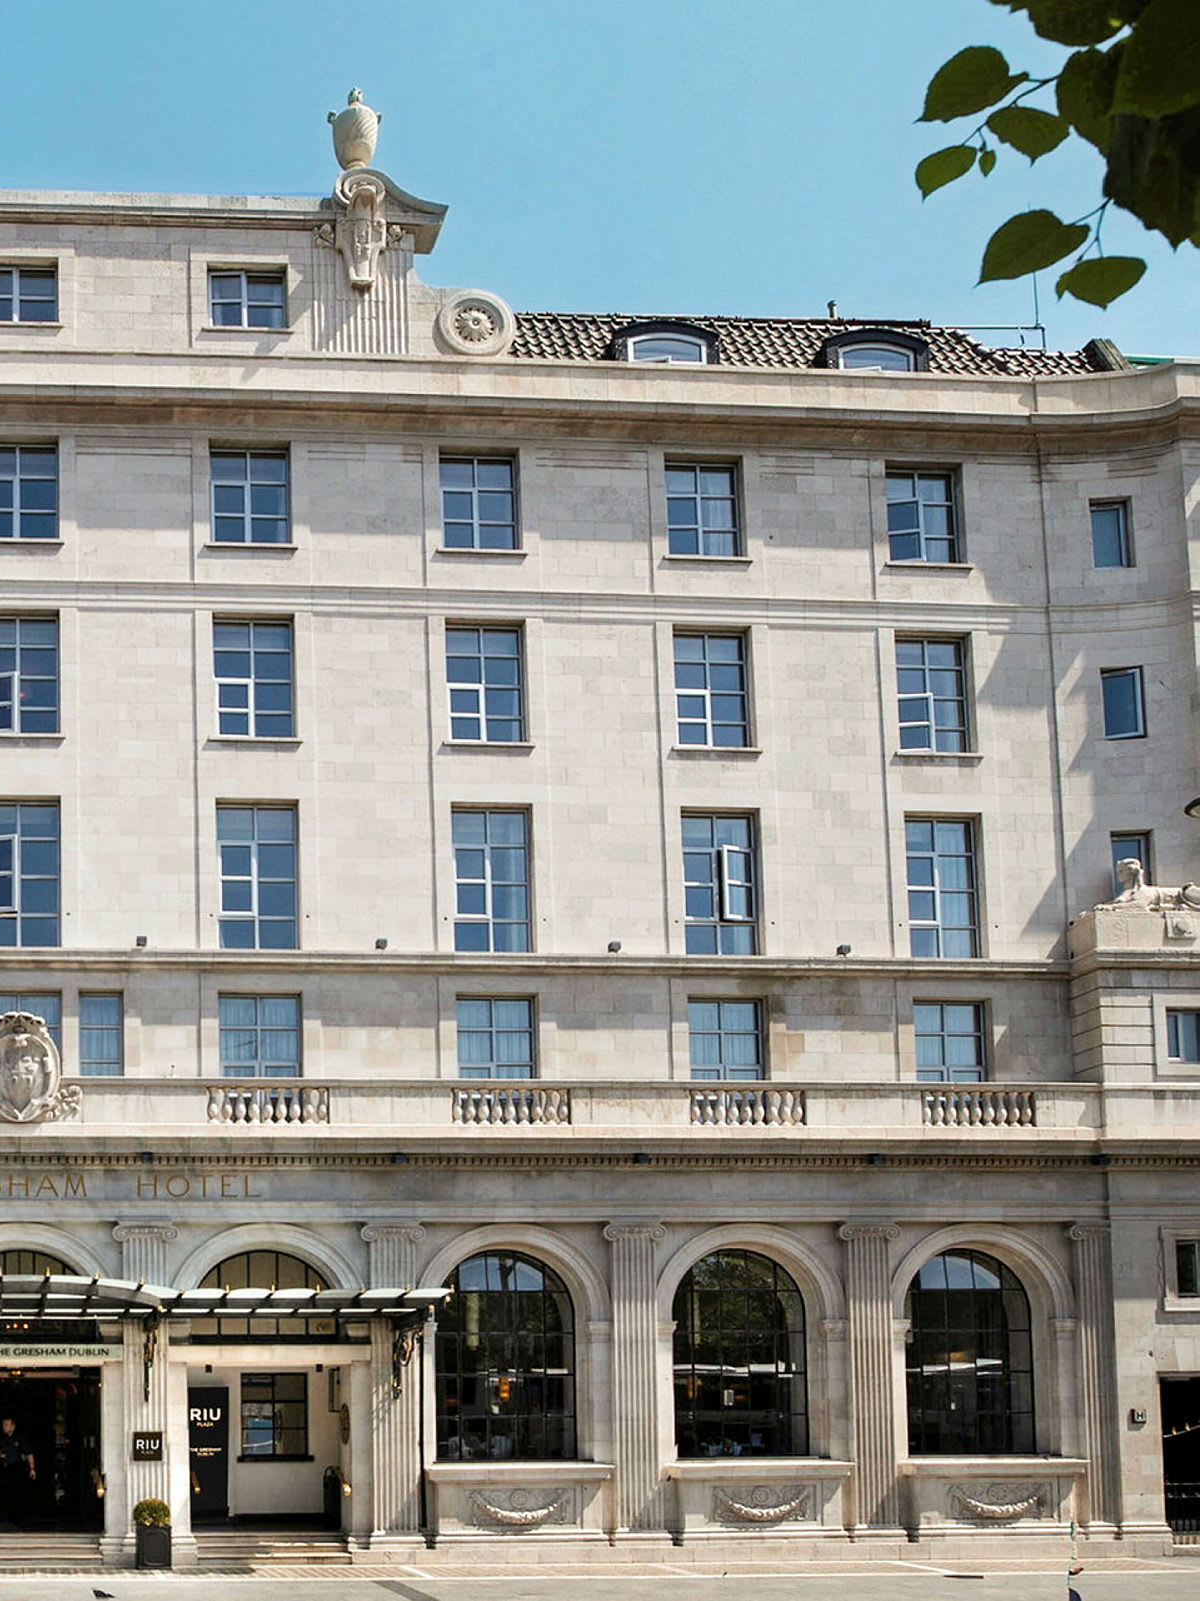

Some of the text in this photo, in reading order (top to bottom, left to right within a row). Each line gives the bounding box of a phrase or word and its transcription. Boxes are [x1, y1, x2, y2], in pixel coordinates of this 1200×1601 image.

[136, 1173, 263, 1198] HOTEL
[13, 1347, 66, 1356] GRESHAM
[69, 1347, 109, 1356] DUBLIN
[190, 1408, 221, 1421] RIU
[136, 1439, 159, 1450] RIU
